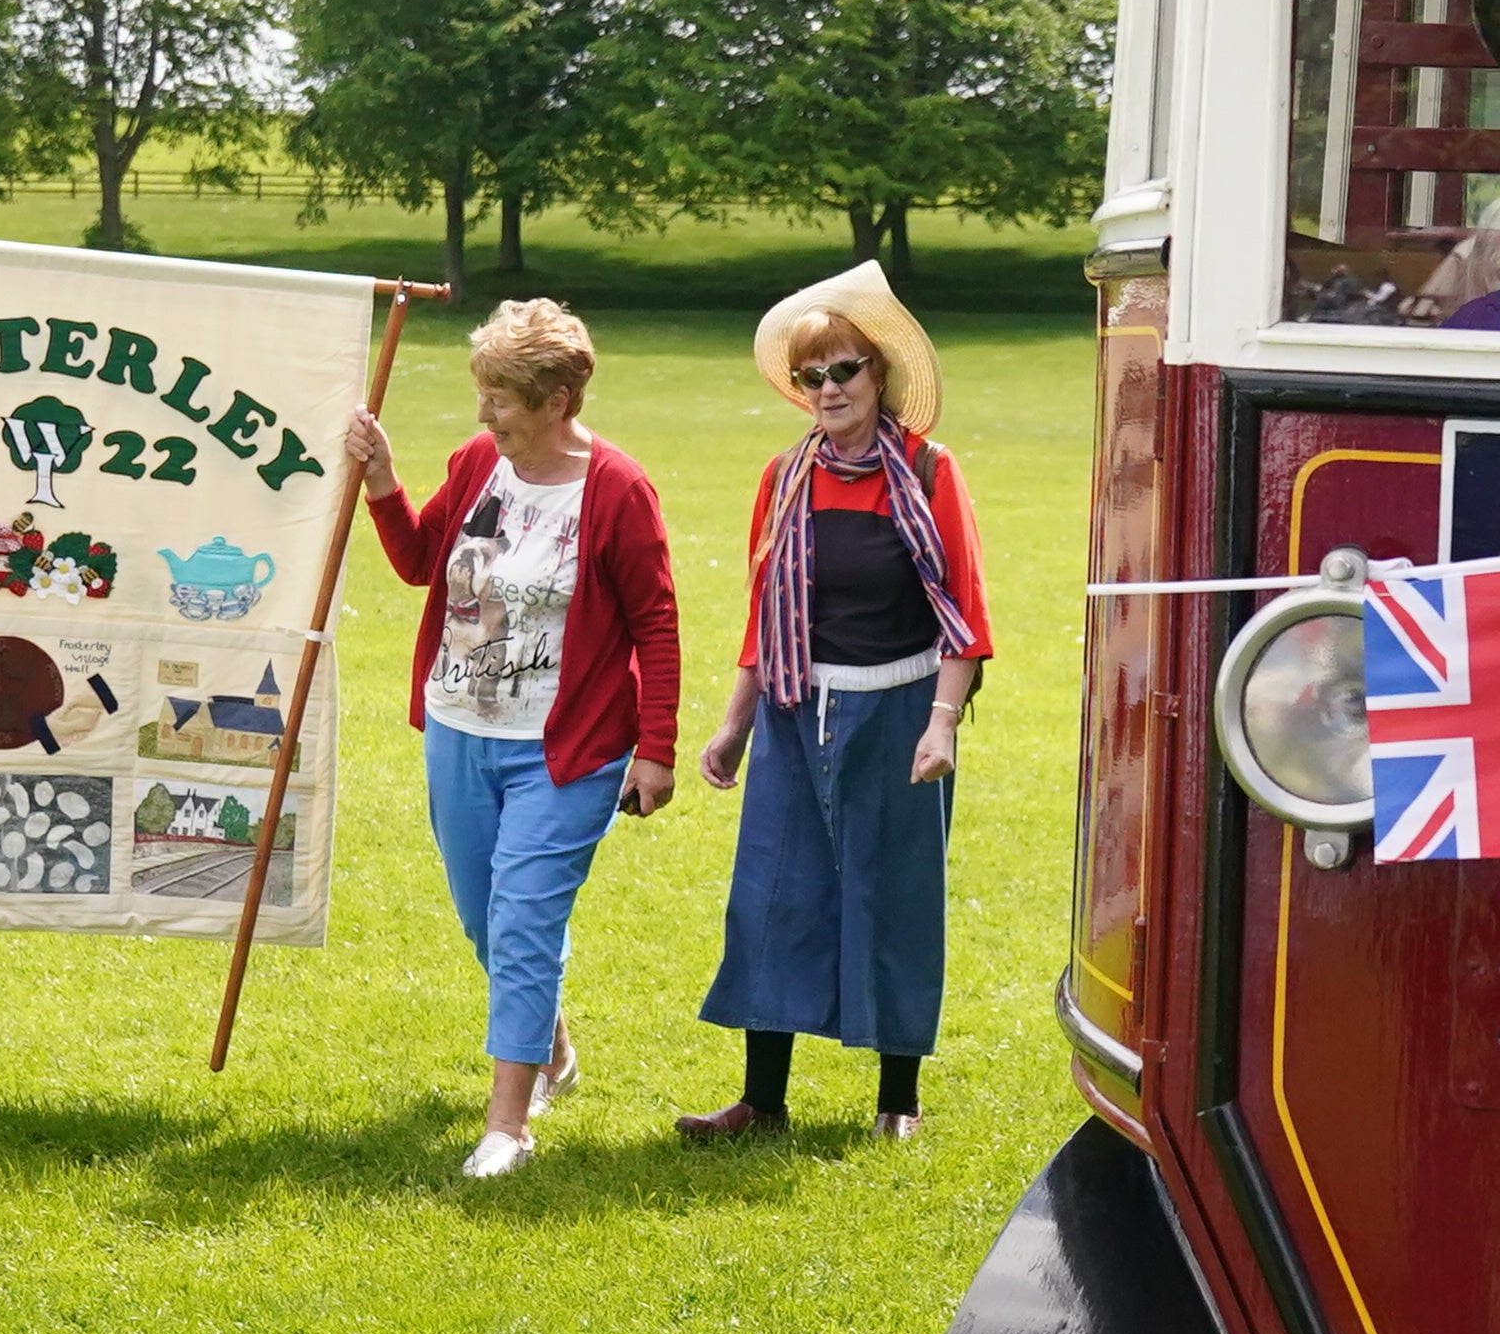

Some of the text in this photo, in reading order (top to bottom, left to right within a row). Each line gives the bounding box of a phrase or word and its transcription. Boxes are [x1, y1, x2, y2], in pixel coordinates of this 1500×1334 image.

[100, 430, 197, 486] 22
[487, 575, 558, 607] Best
[58, 638, 113, 656] Frosterley
[431, 625, 557, 694] British
